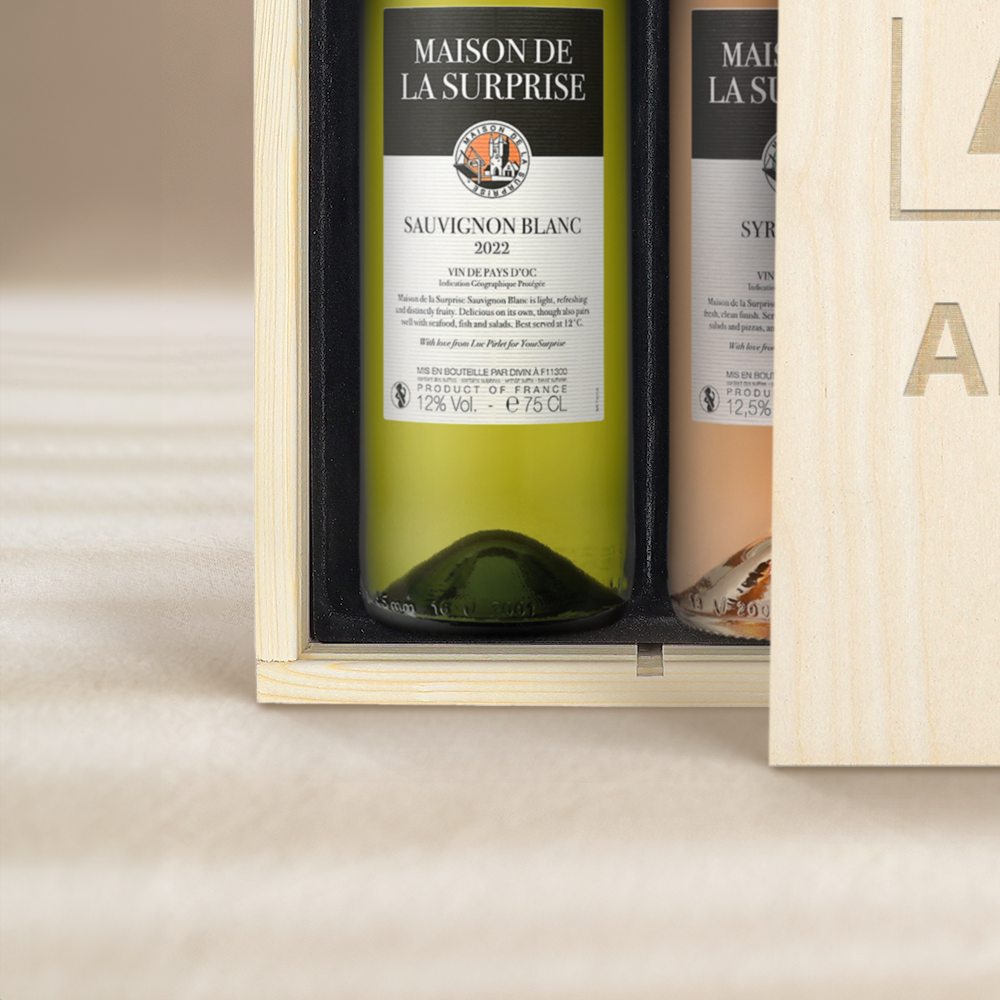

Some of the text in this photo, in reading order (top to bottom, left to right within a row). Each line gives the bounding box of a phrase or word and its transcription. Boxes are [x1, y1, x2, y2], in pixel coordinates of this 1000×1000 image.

[414, 37, 573, 65] MAISON DE
[721, 41, 778, 68] MAI
[401, 72, 586, 101] LA SURPRISE
[708, 76, 746, 104] LA
[463, 124, 506, 146] MAISON
[510, 132, 523, 147] DE
[472, 171, 525, 197] SURPRISE
[404, 216, 581, 235] SAUVIGNON BLANC
[741, 220, 776, 239] SYR
[474, 241, 510, 255] 2022
[448, 267, 465, 277] VIN
[467, 267, 482, 278] DE
[483, 267, 509, 278] PAYS
[757, 271, 775, 281] VIN
[438, 279, 471, 288] Indication
[397, 293, 419, 303] Maison
[420, 295, 428, 304] de
[429, 295, 435, 304] la
[436, 295, 466, 307] Surprise
[467, 296, 507, 307] Sauvignon
[508, 296, 528, 305] Blanc
[530, 296, 537, 305] is
[537, 296, 556, 307] light,
[707, 297, 730, 308] Maison
[730, 299, 739, 308] de
[740, 299, 747, 308] la
[395, 306, 406, 315] and
[436, 307, 458, 319] fruity.
[459, 307, 495, 317] Delicious
[507, 307, 517, 317] its
[517, 310, 536, 318] own,
[537, 307, 562, 319] though
[721, 310, 738, 319] clean
[739, 310, 761, 320] finish.
[400, 318, 413, 327] well
[413, 318, 428, 328] with
[428, 319, 458, 330] seafood,
[458, 320, 473, 328] fish
[473, 320, 488, 329] and
[515, 320, 531, 329] Best
[556, 320, 563, 329] at
[727, 322, 741, 332] and
[741, 323, 765, 333] pizzas,
[419, 337, 436, 347] With
[436, 338, 451, 348] love
[450, 339, 470, 350] from
[505, 339, 520, 350] for
[745, 342, 760, 351] love
[416, 366, 431, 375] MIS
[431, 367, 443, 376] EN
[444, 367, 489, 377] BOUTEILLE
[490, 368, 508, 377] PAR
[726, 370, 740, 379] MIS
[741, 371, 752, 380] EN
[416, 383, 568, 395] PRODUCT OF FRANCE
[726, 387, 771, 398] PRODU
[417, 394, 447, 412] 12%
[450, 395, 478, 413] Vol.
[546, 394, 569, 413] CL
[726, 398, 773, 418] 12,5%
